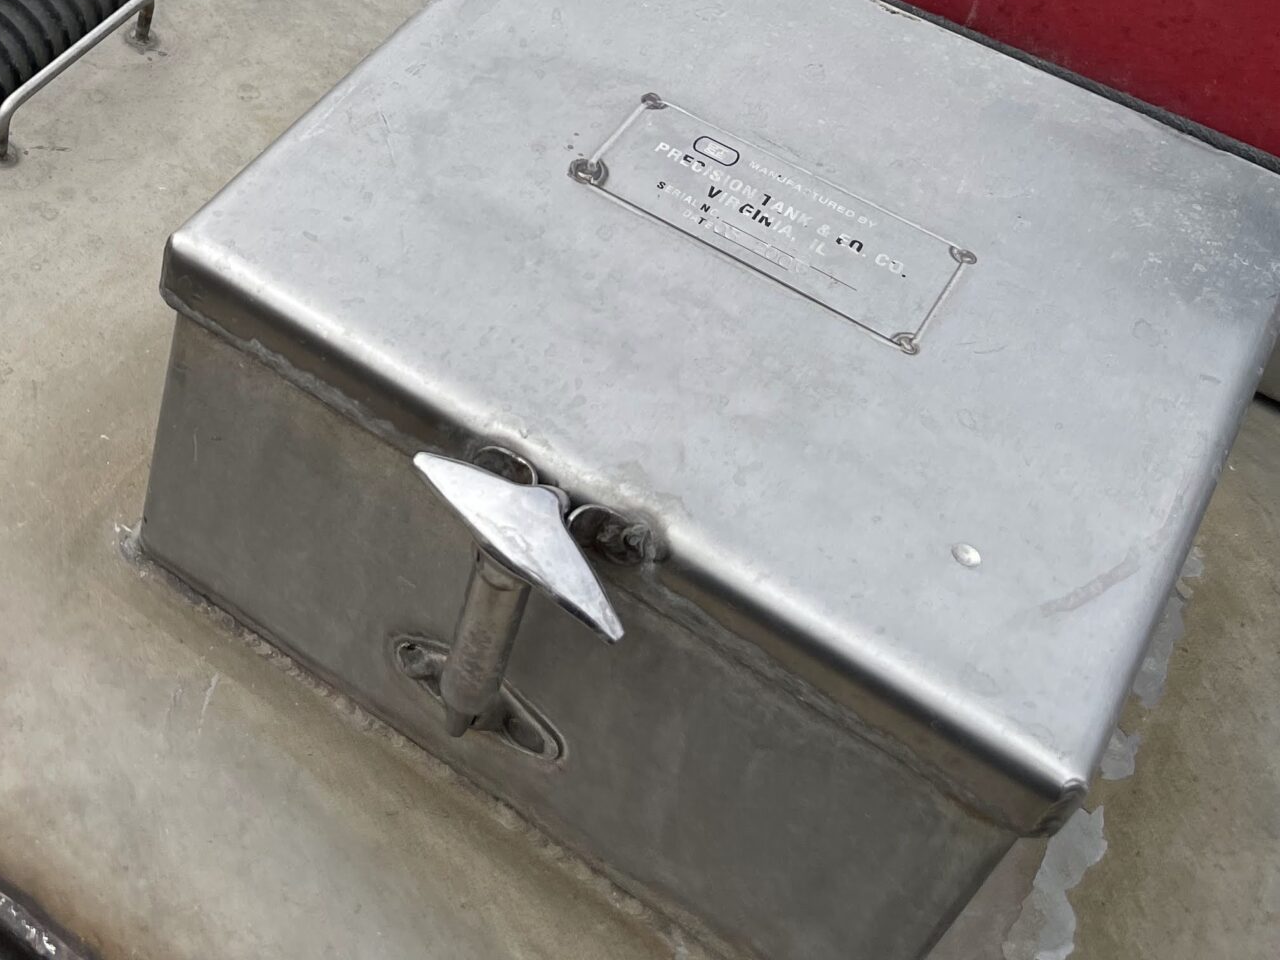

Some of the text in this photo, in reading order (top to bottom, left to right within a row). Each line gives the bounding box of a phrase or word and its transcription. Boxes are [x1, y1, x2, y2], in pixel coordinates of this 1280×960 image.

[655, 180, 696, 207] SERIAL
[653, 141, 758, 199] PRECISION
[761, 193, 814, 228] TANK
[815, 222, 831, 238] &
[873, 252, 906, 278] CO.
[681, 208, 714, 230] DATE
